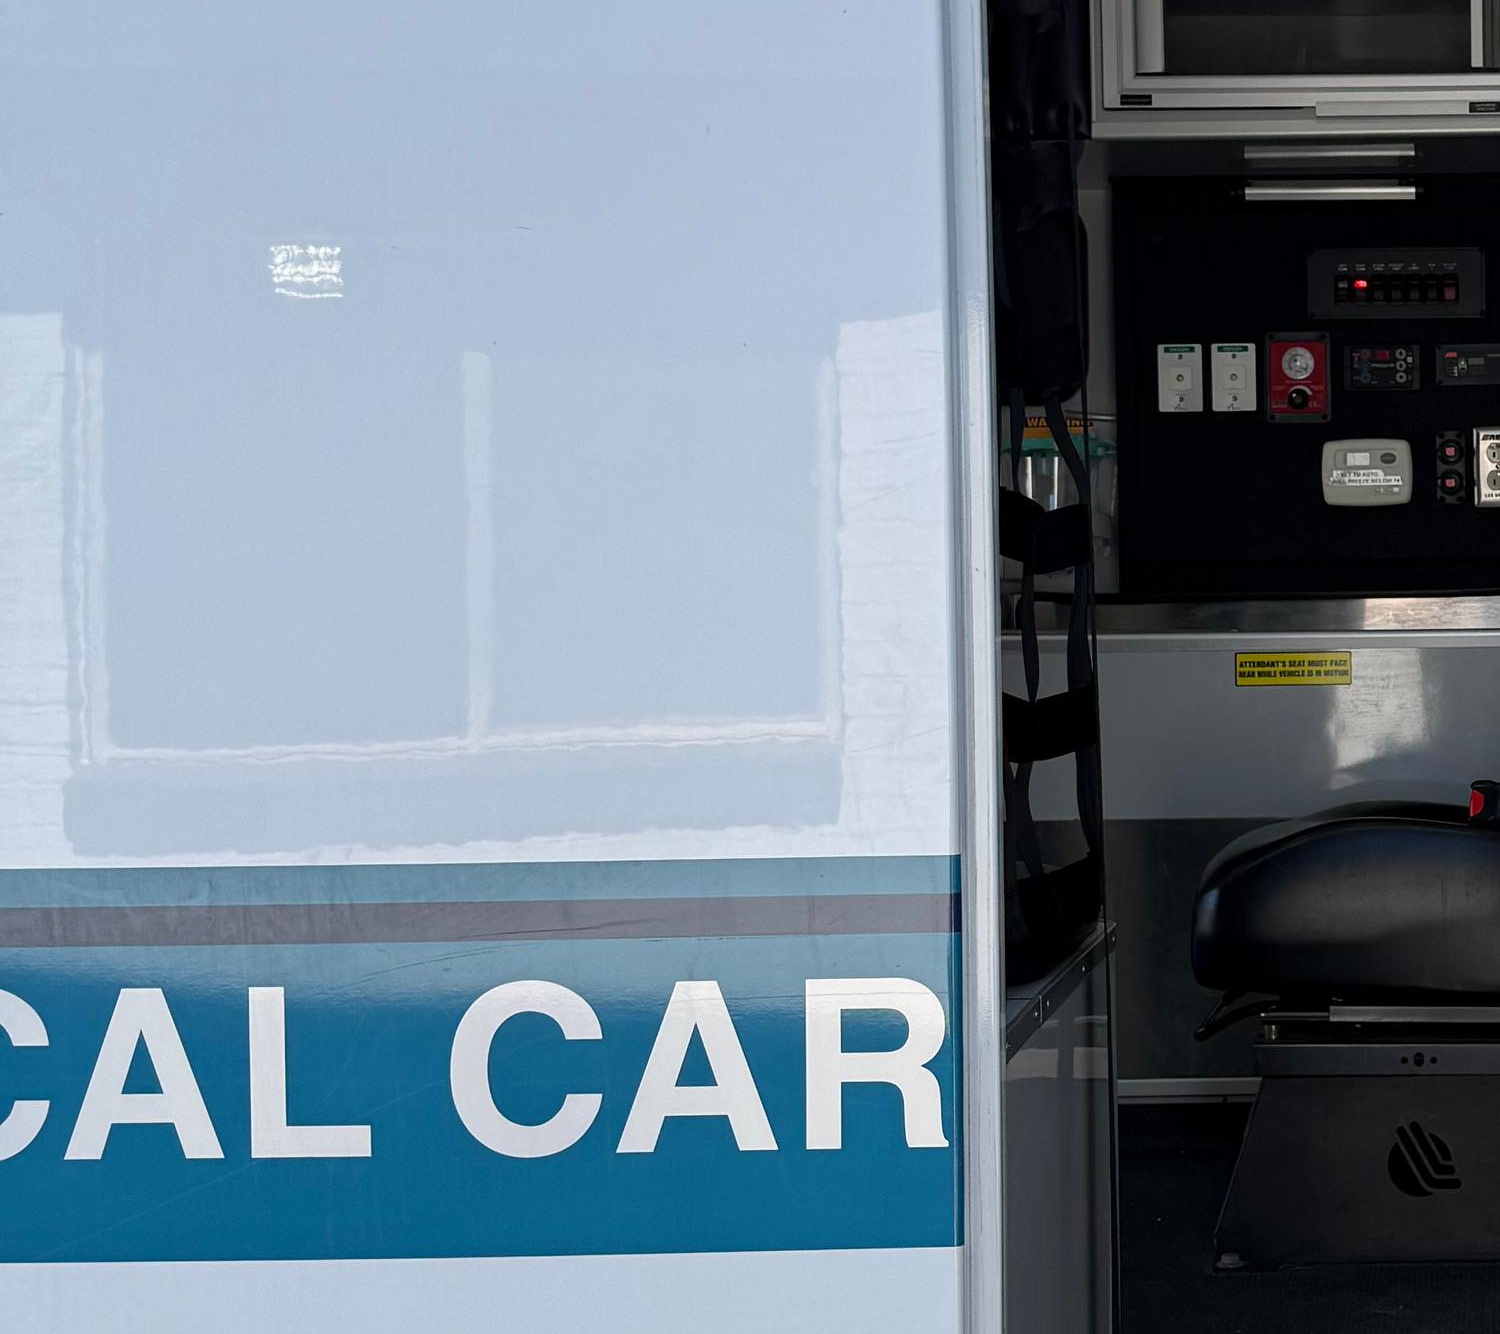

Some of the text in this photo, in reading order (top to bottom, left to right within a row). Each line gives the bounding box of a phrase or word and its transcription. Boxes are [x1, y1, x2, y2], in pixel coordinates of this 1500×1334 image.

[1240, 660, 1286, 668] ATTENDANT'S
[1308, 659, 1328, 667] MUST
[449, 978, 950, 1158] CAR
